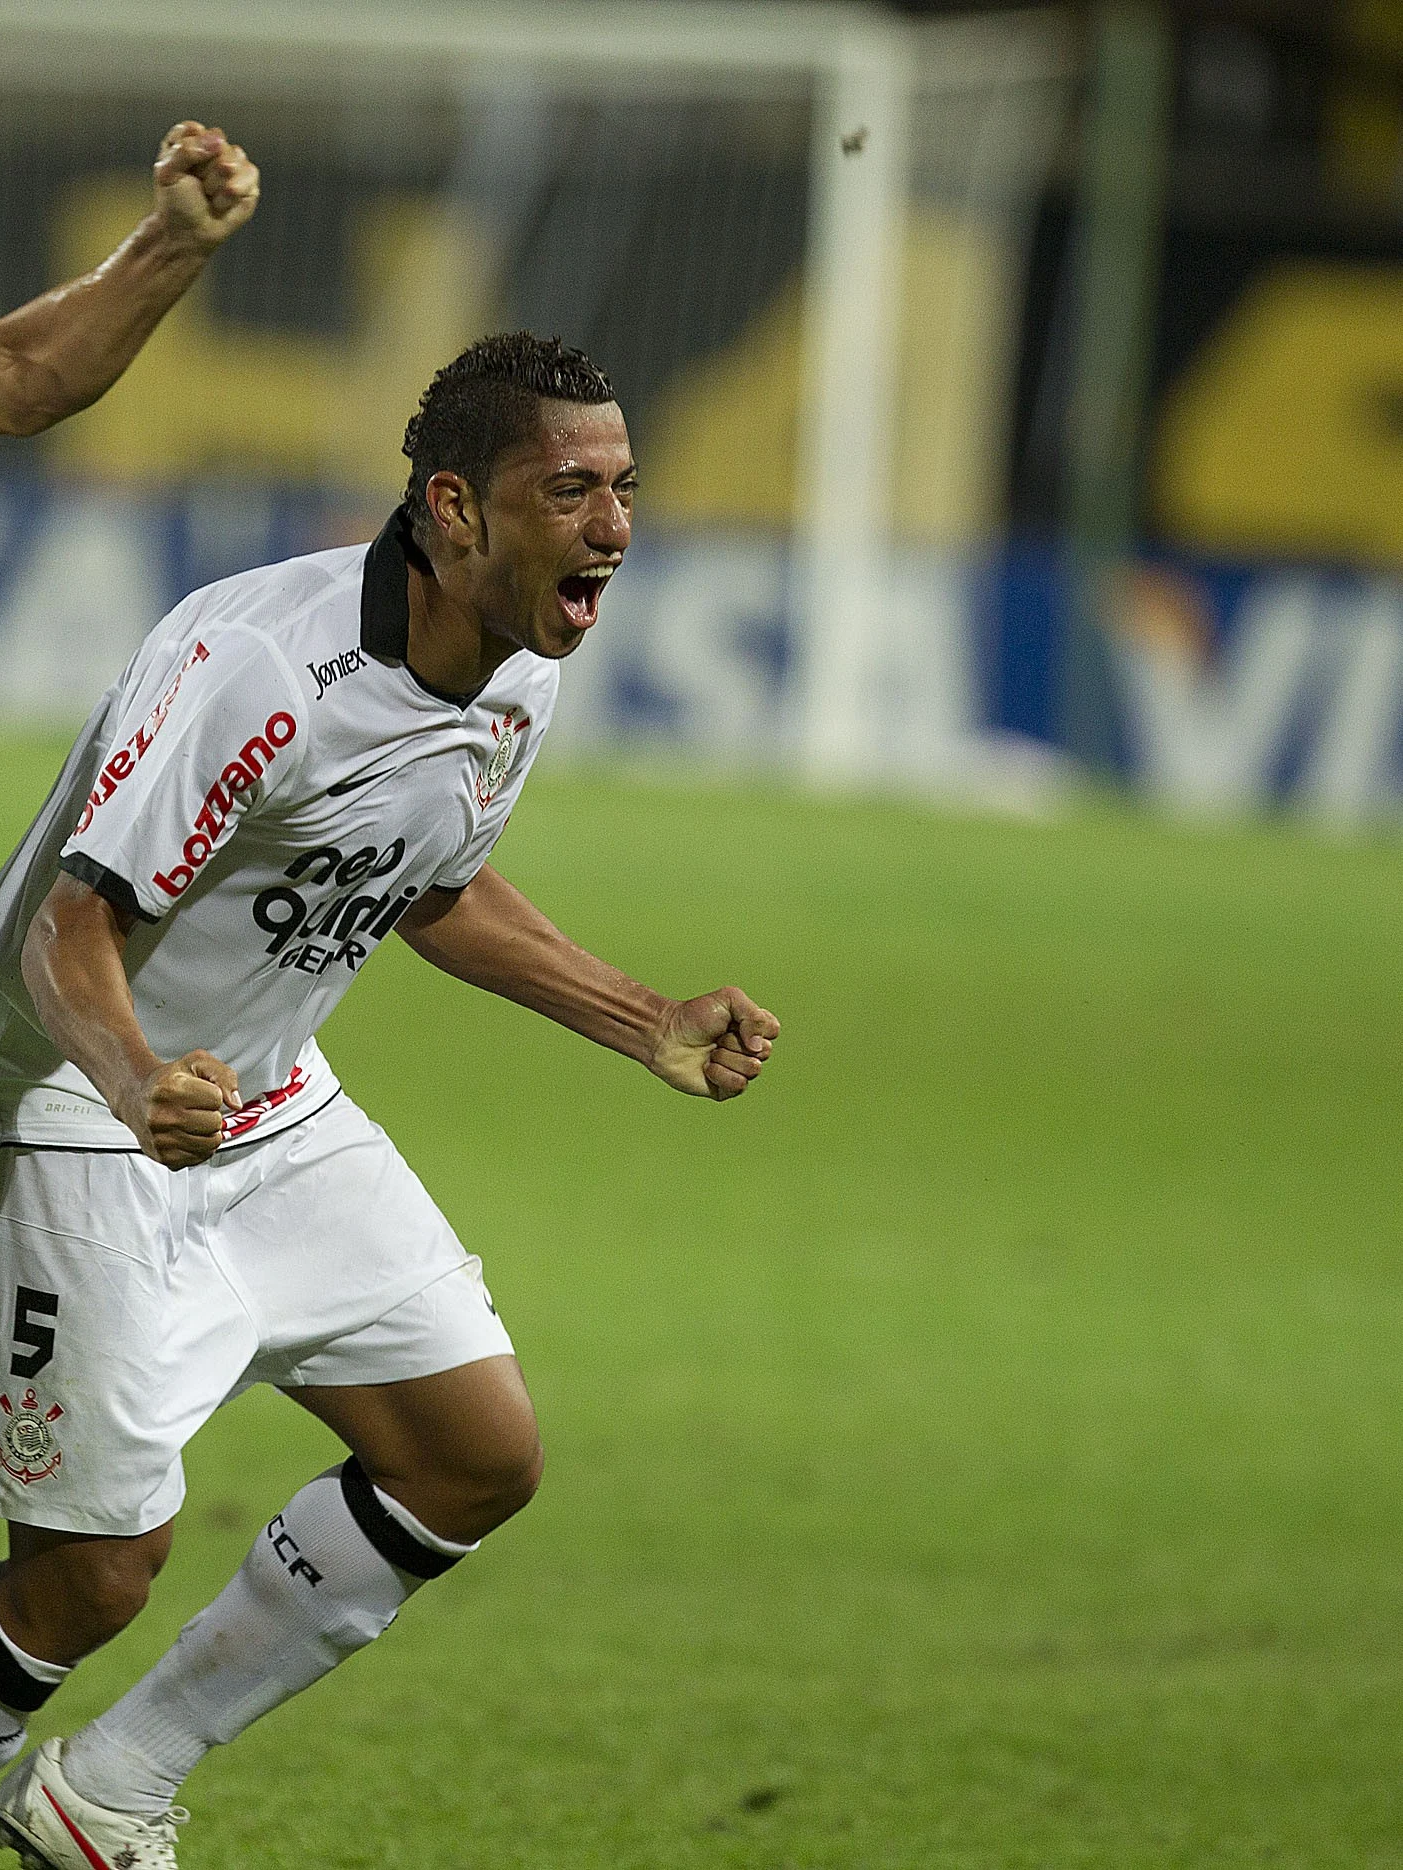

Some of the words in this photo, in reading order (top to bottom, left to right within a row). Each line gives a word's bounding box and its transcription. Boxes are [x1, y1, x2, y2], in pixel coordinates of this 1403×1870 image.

[152, 711, 297, 898] bozzano
[284, 837, 405, 888] neo
[10, 1285, 59, 1379] 5
